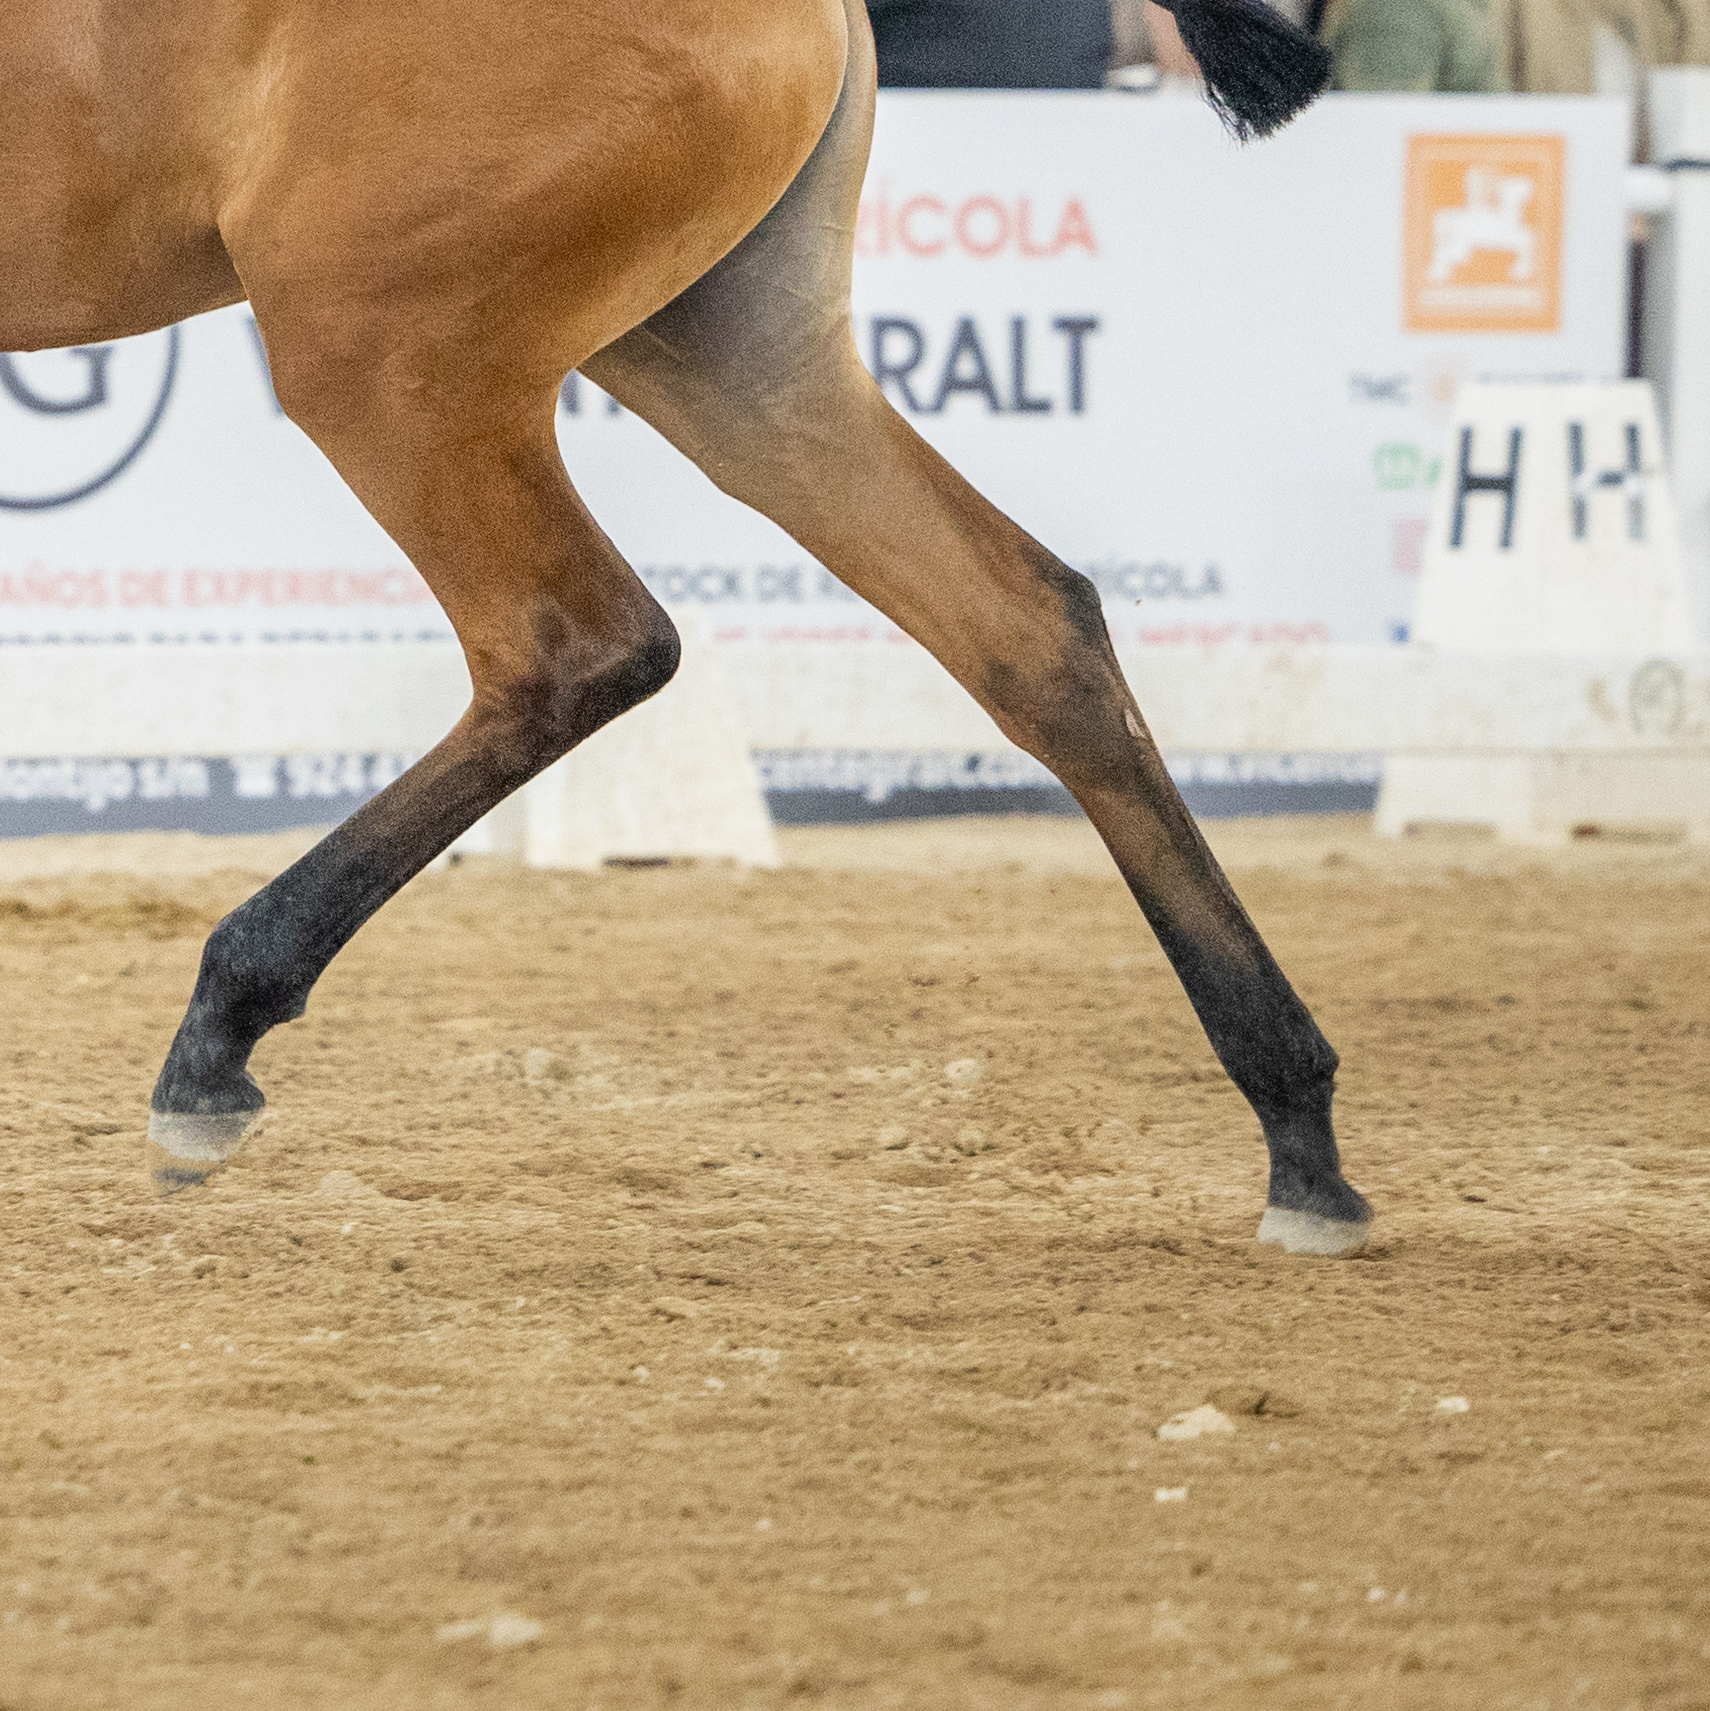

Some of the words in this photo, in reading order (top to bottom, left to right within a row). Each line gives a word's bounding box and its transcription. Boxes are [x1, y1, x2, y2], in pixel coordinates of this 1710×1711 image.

[1448, 419, 1526, 552] H
[119, 568, 173, 608] DE
[632, 564, 744, 605] TOCK
